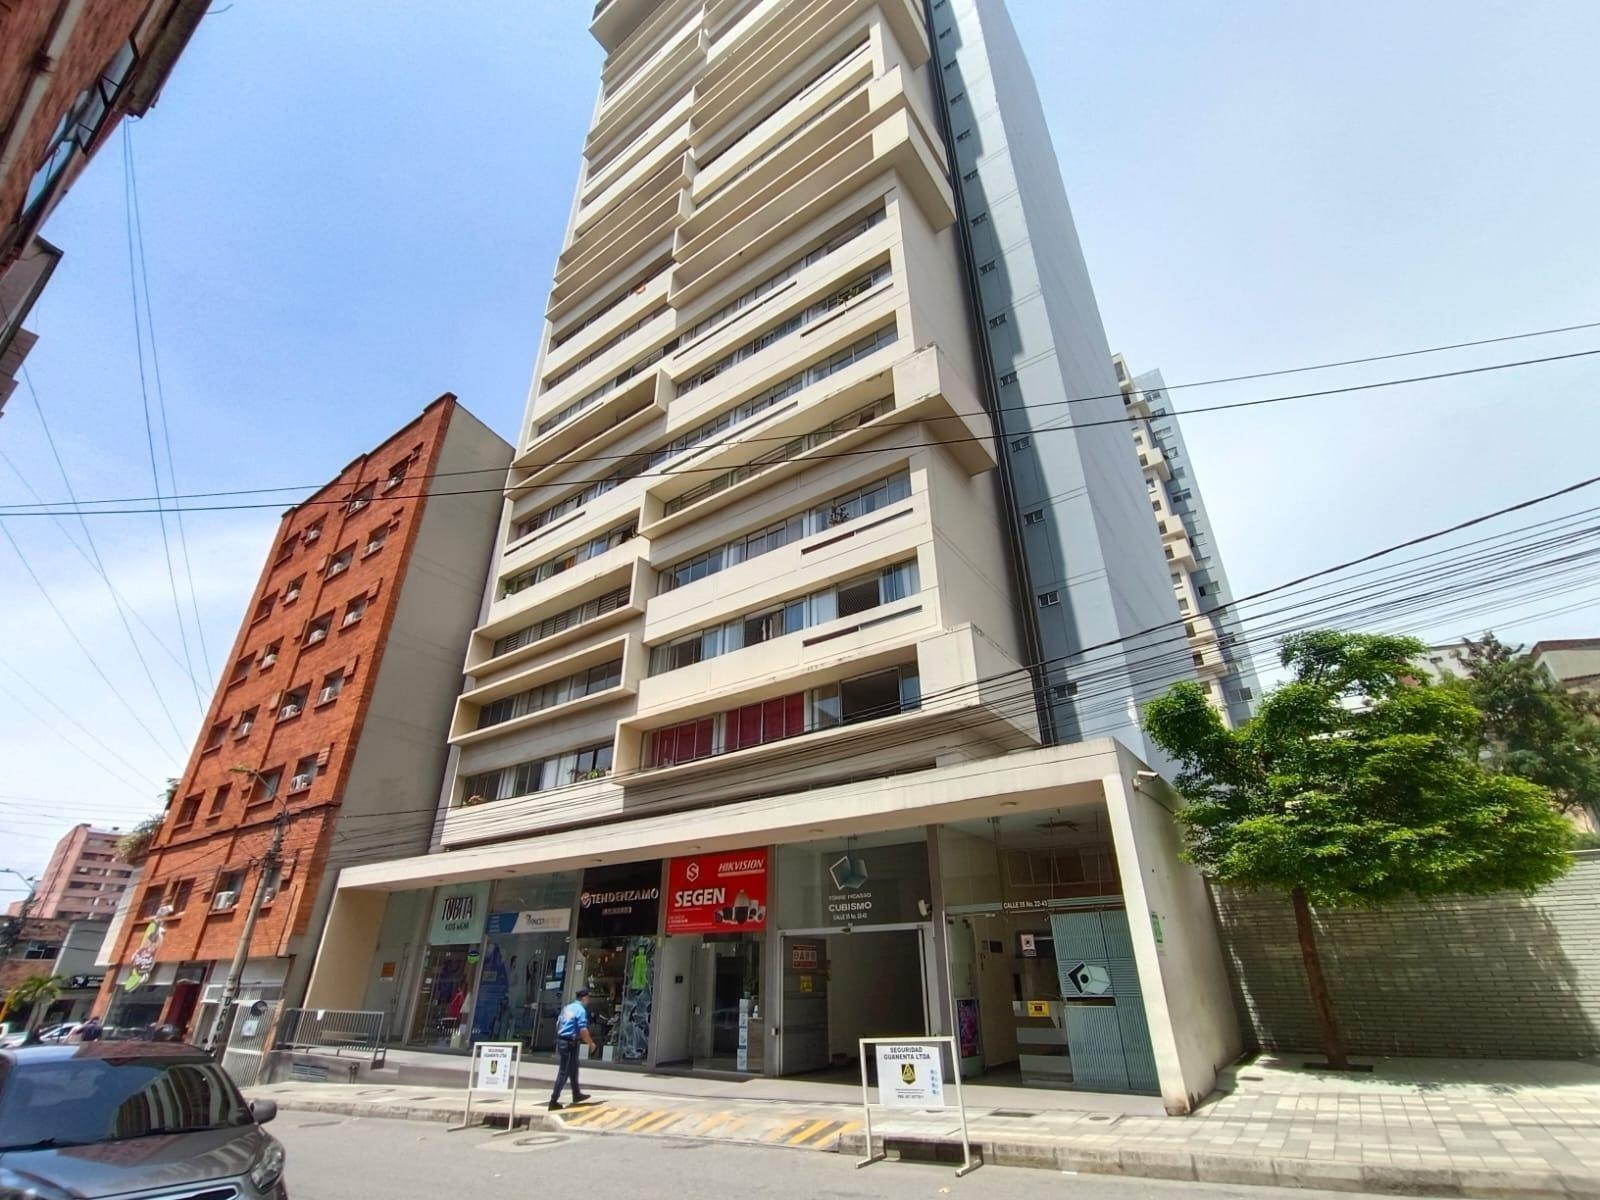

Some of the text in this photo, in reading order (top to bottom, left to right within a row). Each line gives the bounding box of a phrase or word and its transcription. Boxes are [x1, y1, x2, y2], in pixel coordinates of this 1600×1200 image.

[718, 858, 765, 873] HIKVISION
[674, 887, 726, 907] SEGEN
[828, 901, 872, 912] CUBISMO
